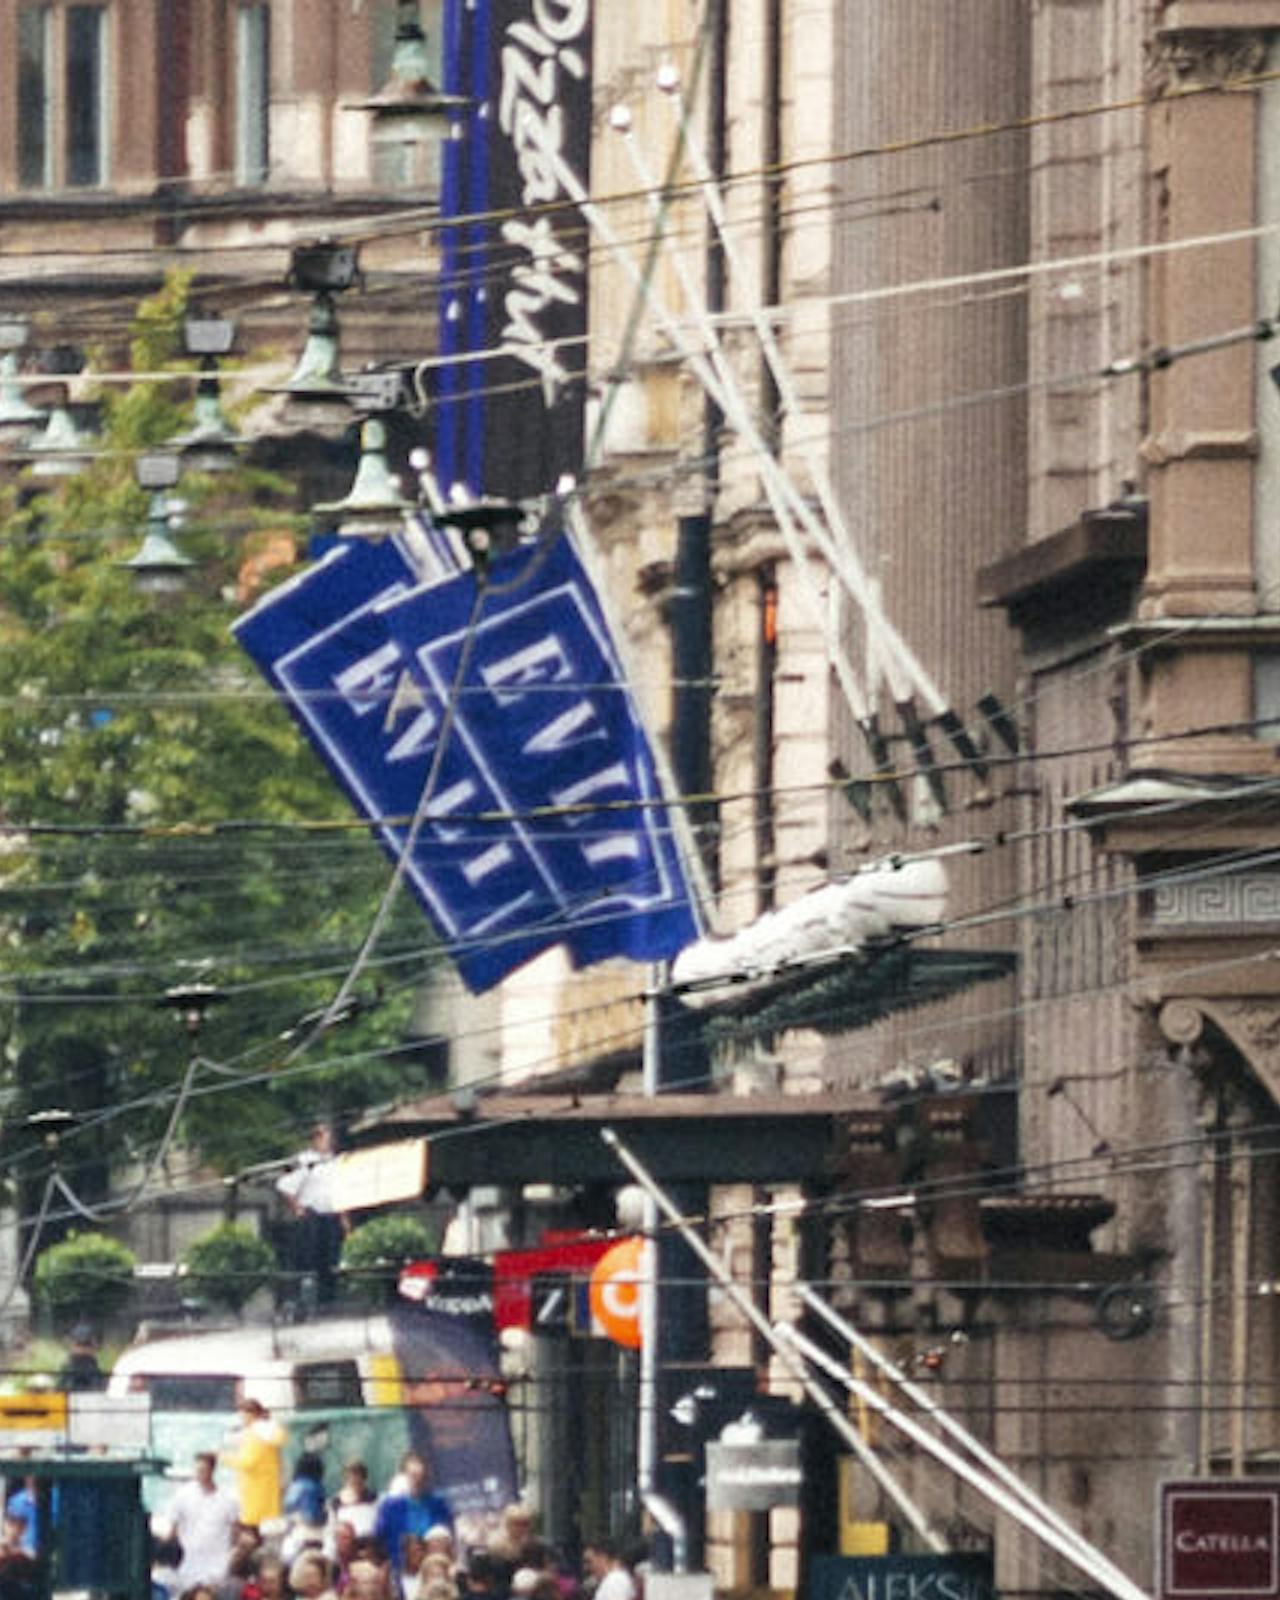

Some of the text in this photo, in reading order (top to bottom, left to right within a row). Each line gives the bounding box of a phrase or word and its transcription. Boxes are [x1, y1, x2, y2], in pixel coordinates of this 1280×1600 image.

[501, 216, 582, 408] Hut
[333, 641, 515, 887] EVLI
[480, 634, 640, 868] EVLI
